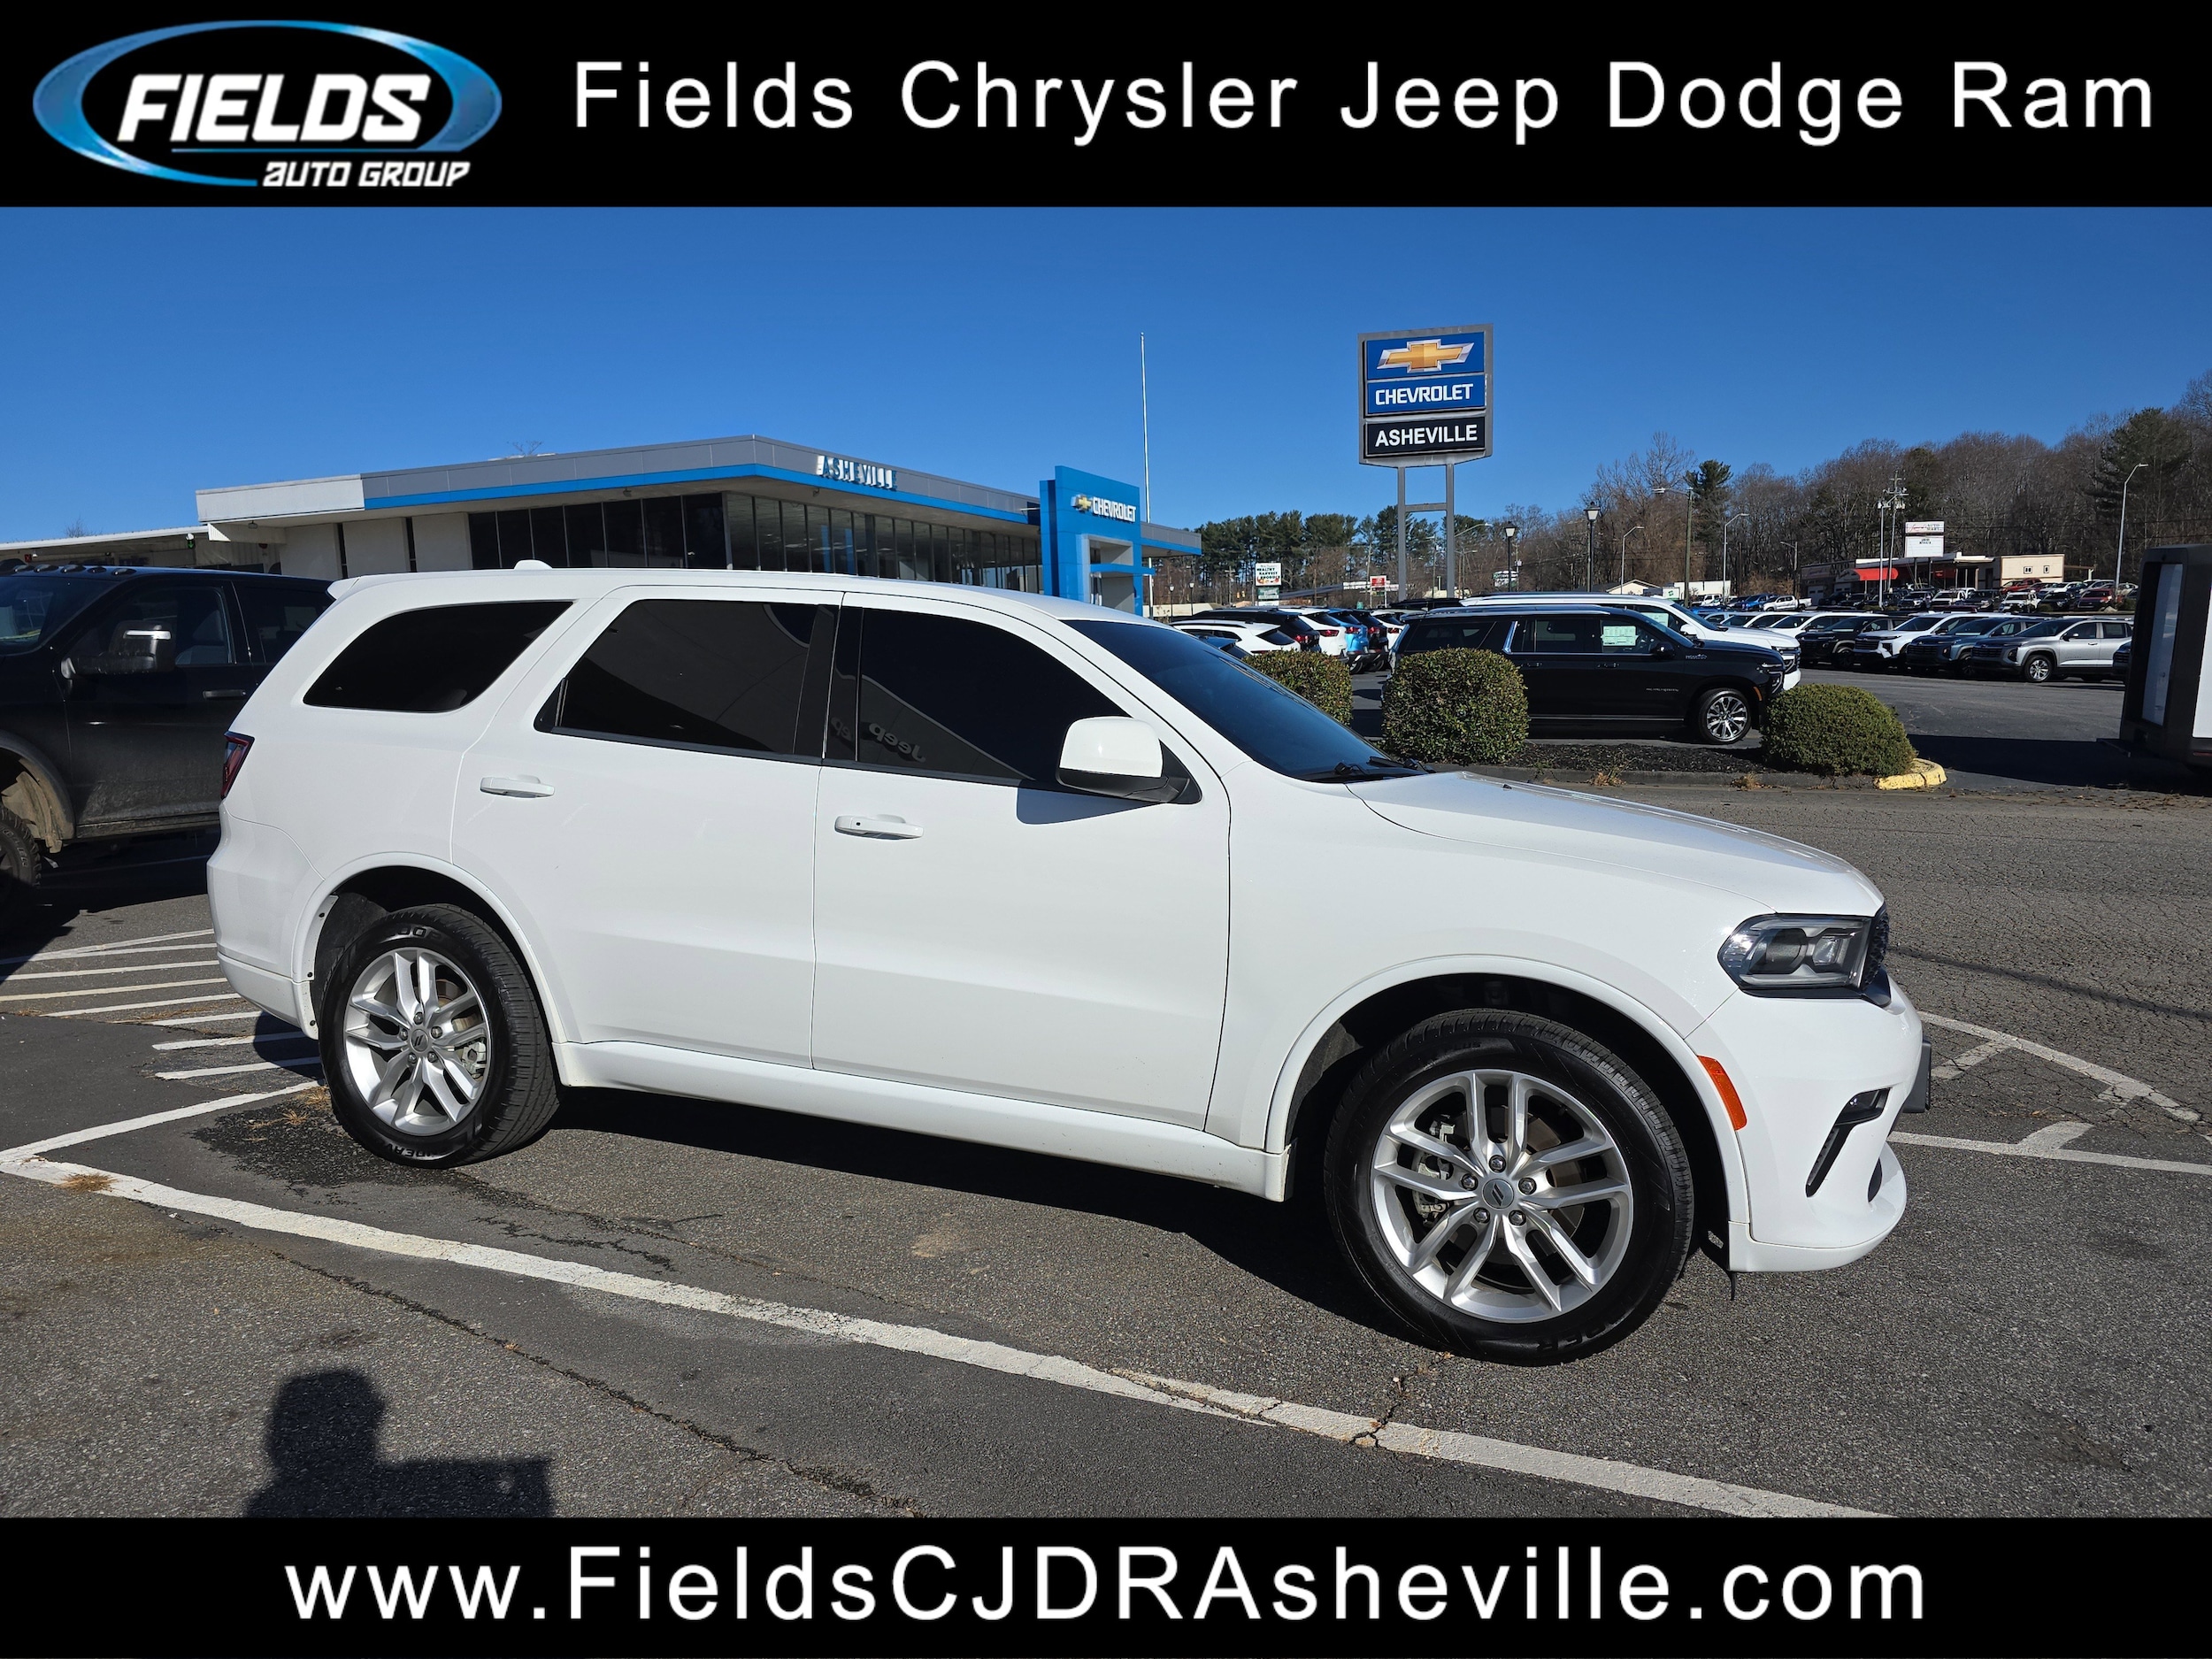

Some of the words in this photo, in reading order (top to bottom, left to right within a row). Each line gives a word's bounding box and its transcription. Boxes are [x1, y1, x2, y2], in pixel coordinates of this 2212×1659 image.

[1375, 383, 1474, 405] CHEVROLET
[1375, 424, 1478, 447] ASHEVILLE
[816, 454, 897, 492] ASHEVILLE
[1093, 496, 1137, 523] CHEVROLET
